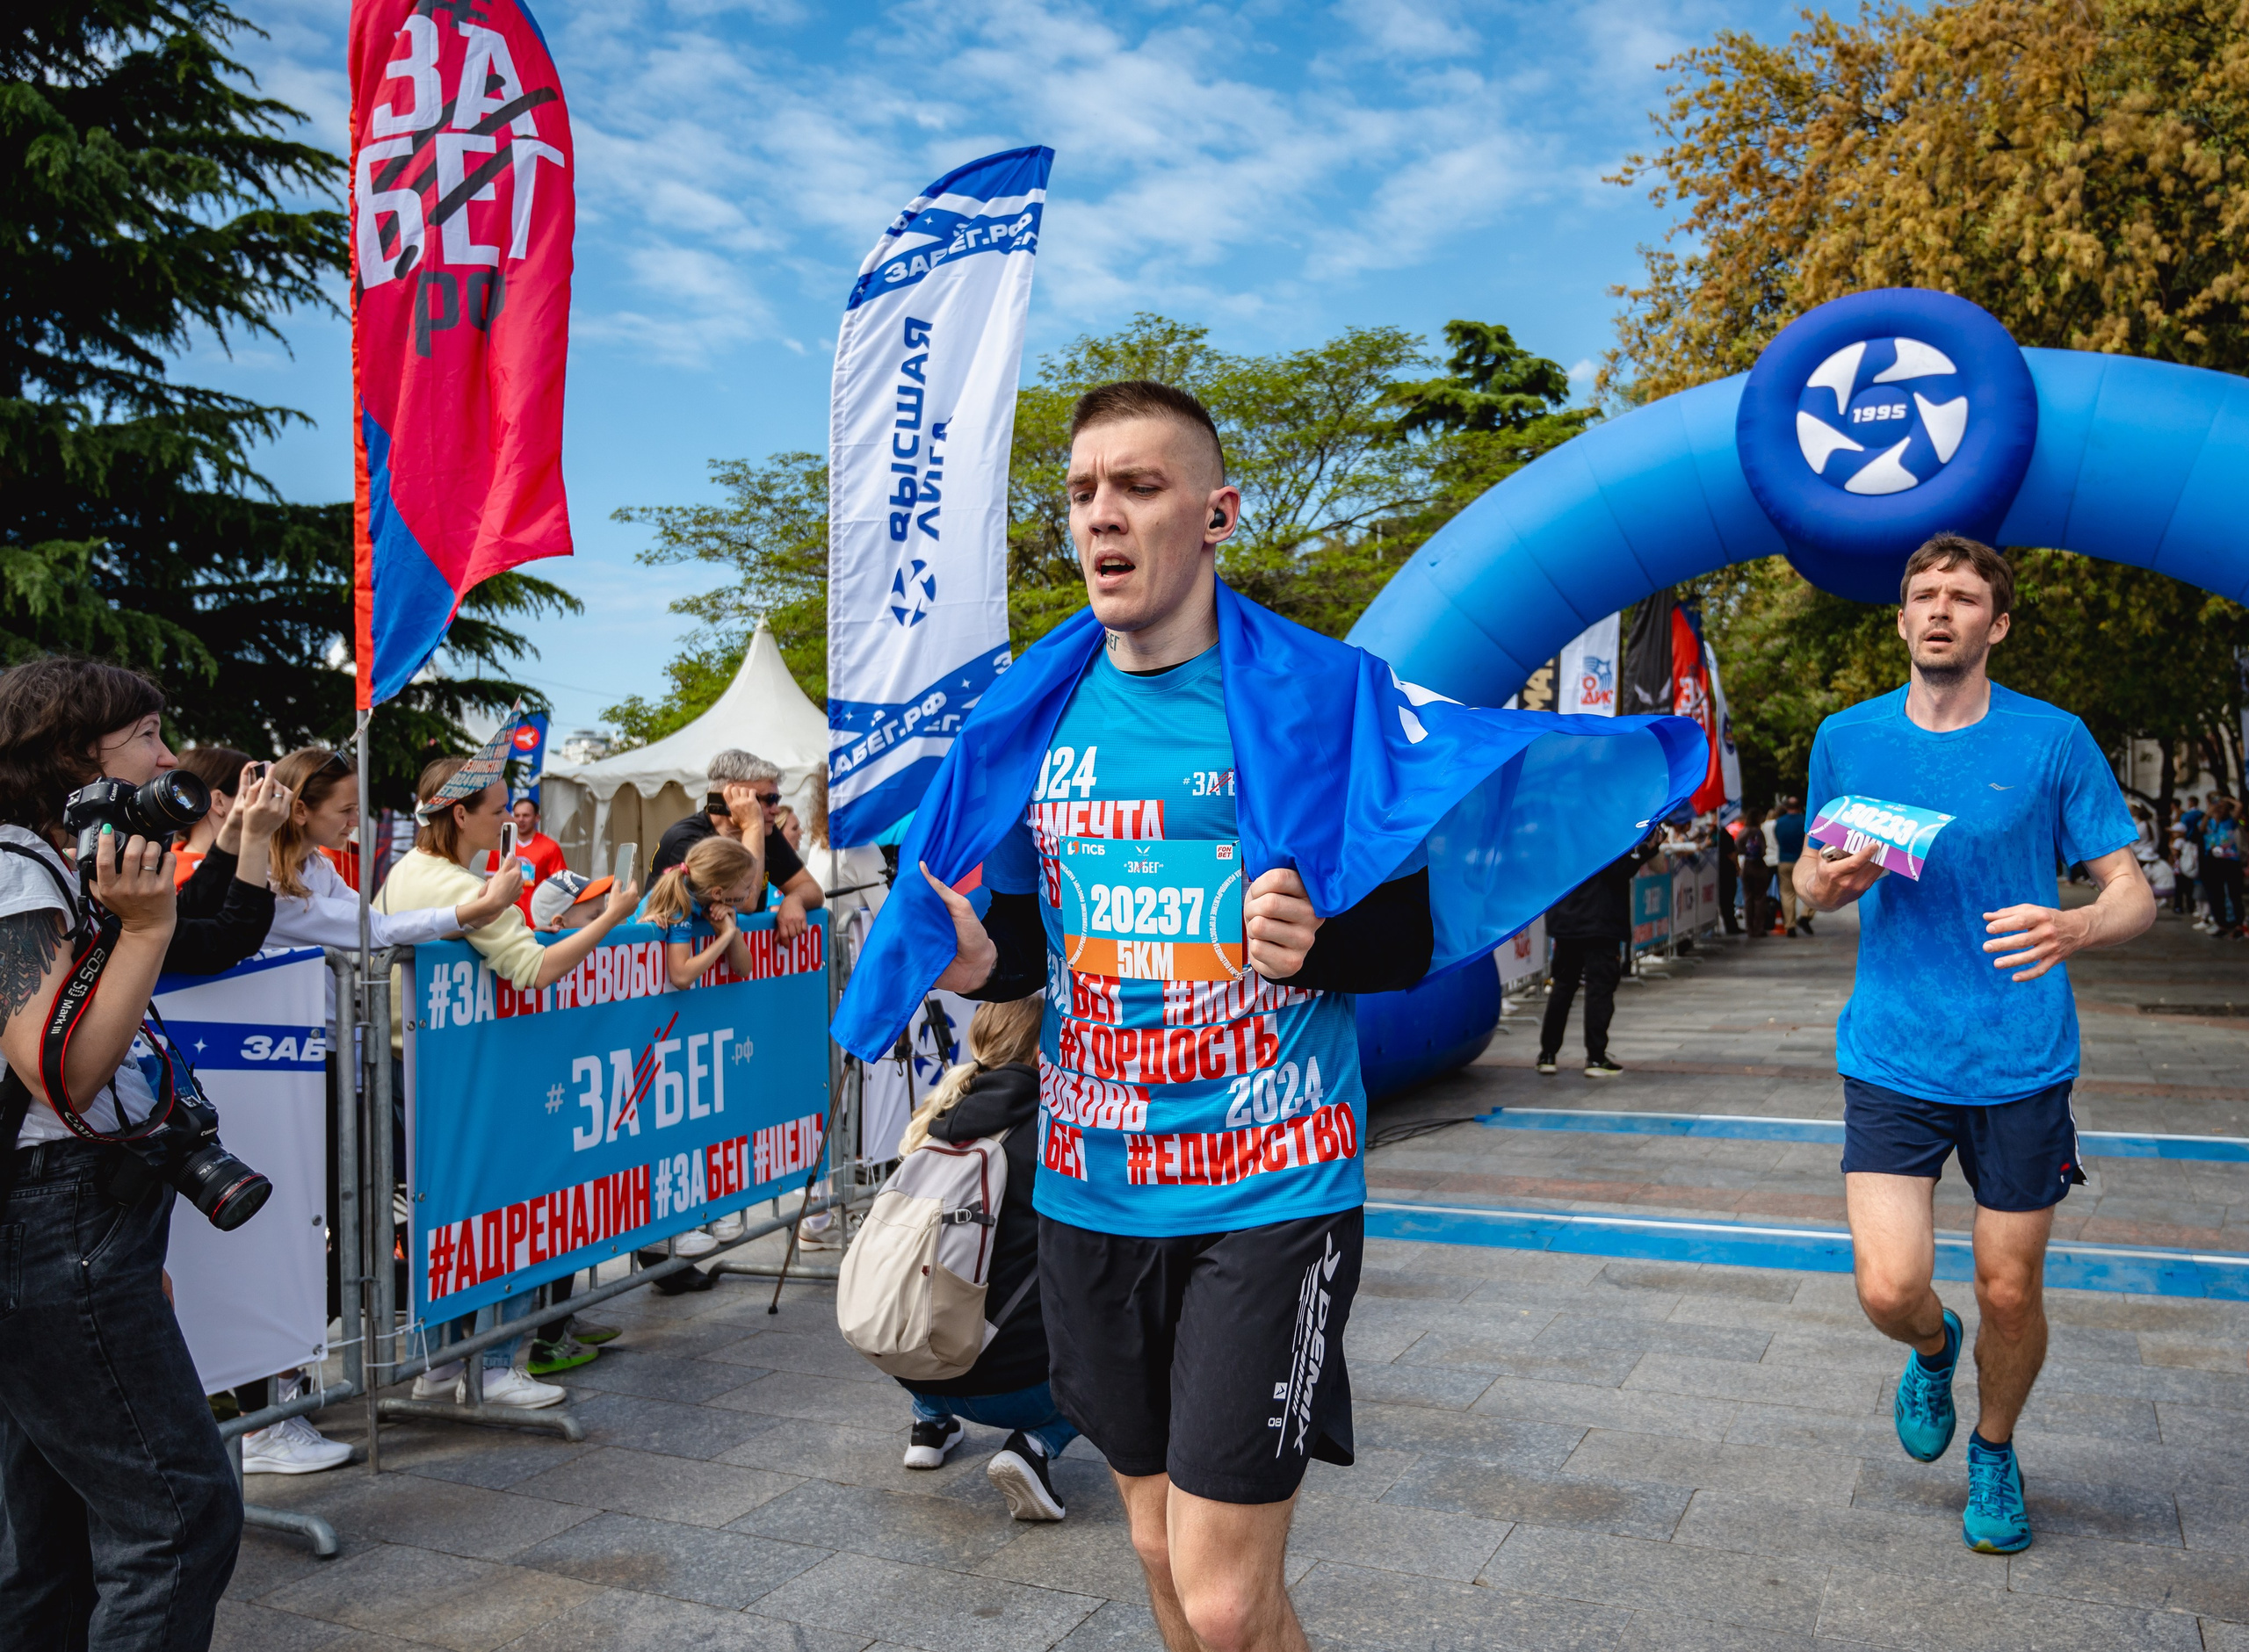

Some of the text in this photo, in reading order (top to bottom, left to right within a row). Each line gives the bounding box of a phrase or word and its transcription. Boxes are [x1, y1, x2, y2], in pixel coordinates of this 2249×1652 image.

[355, 132, 565, 290] БЕГ
[1853, 403, 1907, 423] 1995
[109, 783, 119, 802] Canon
[1030, 746, 1097, 801] 024
[1081, 843, 1105, 855] ПСБ
[1840, 803, 1919, 846] 30233
[1090, 884, 1204, 935] 20237
[51, 948, 105, 1035] EOS 5D Mark III
[556, 940, 696, 1010] #СВОБО
[699, 924, 823, 988] #ЕИНСТВО
[1162, 972, 1325, 1026] #МОМ
[1059, 1013, 1279, 1085] #ГОРДОСТЬ
[1226, 1055, 1324, 1128] 2024
[64, 1111, 115, 1142] Can
[1124, 1102, 1357, 1187] #ЕДИНСТВО
[427, 1113, 824, 1302] #АДРЕНАЛИН #ЗАБЕГ #ЦЕЛЬ
[1293, 1288, 1331, 1456] DEMIX
[1268, 1418, 1283, 1427] 08
